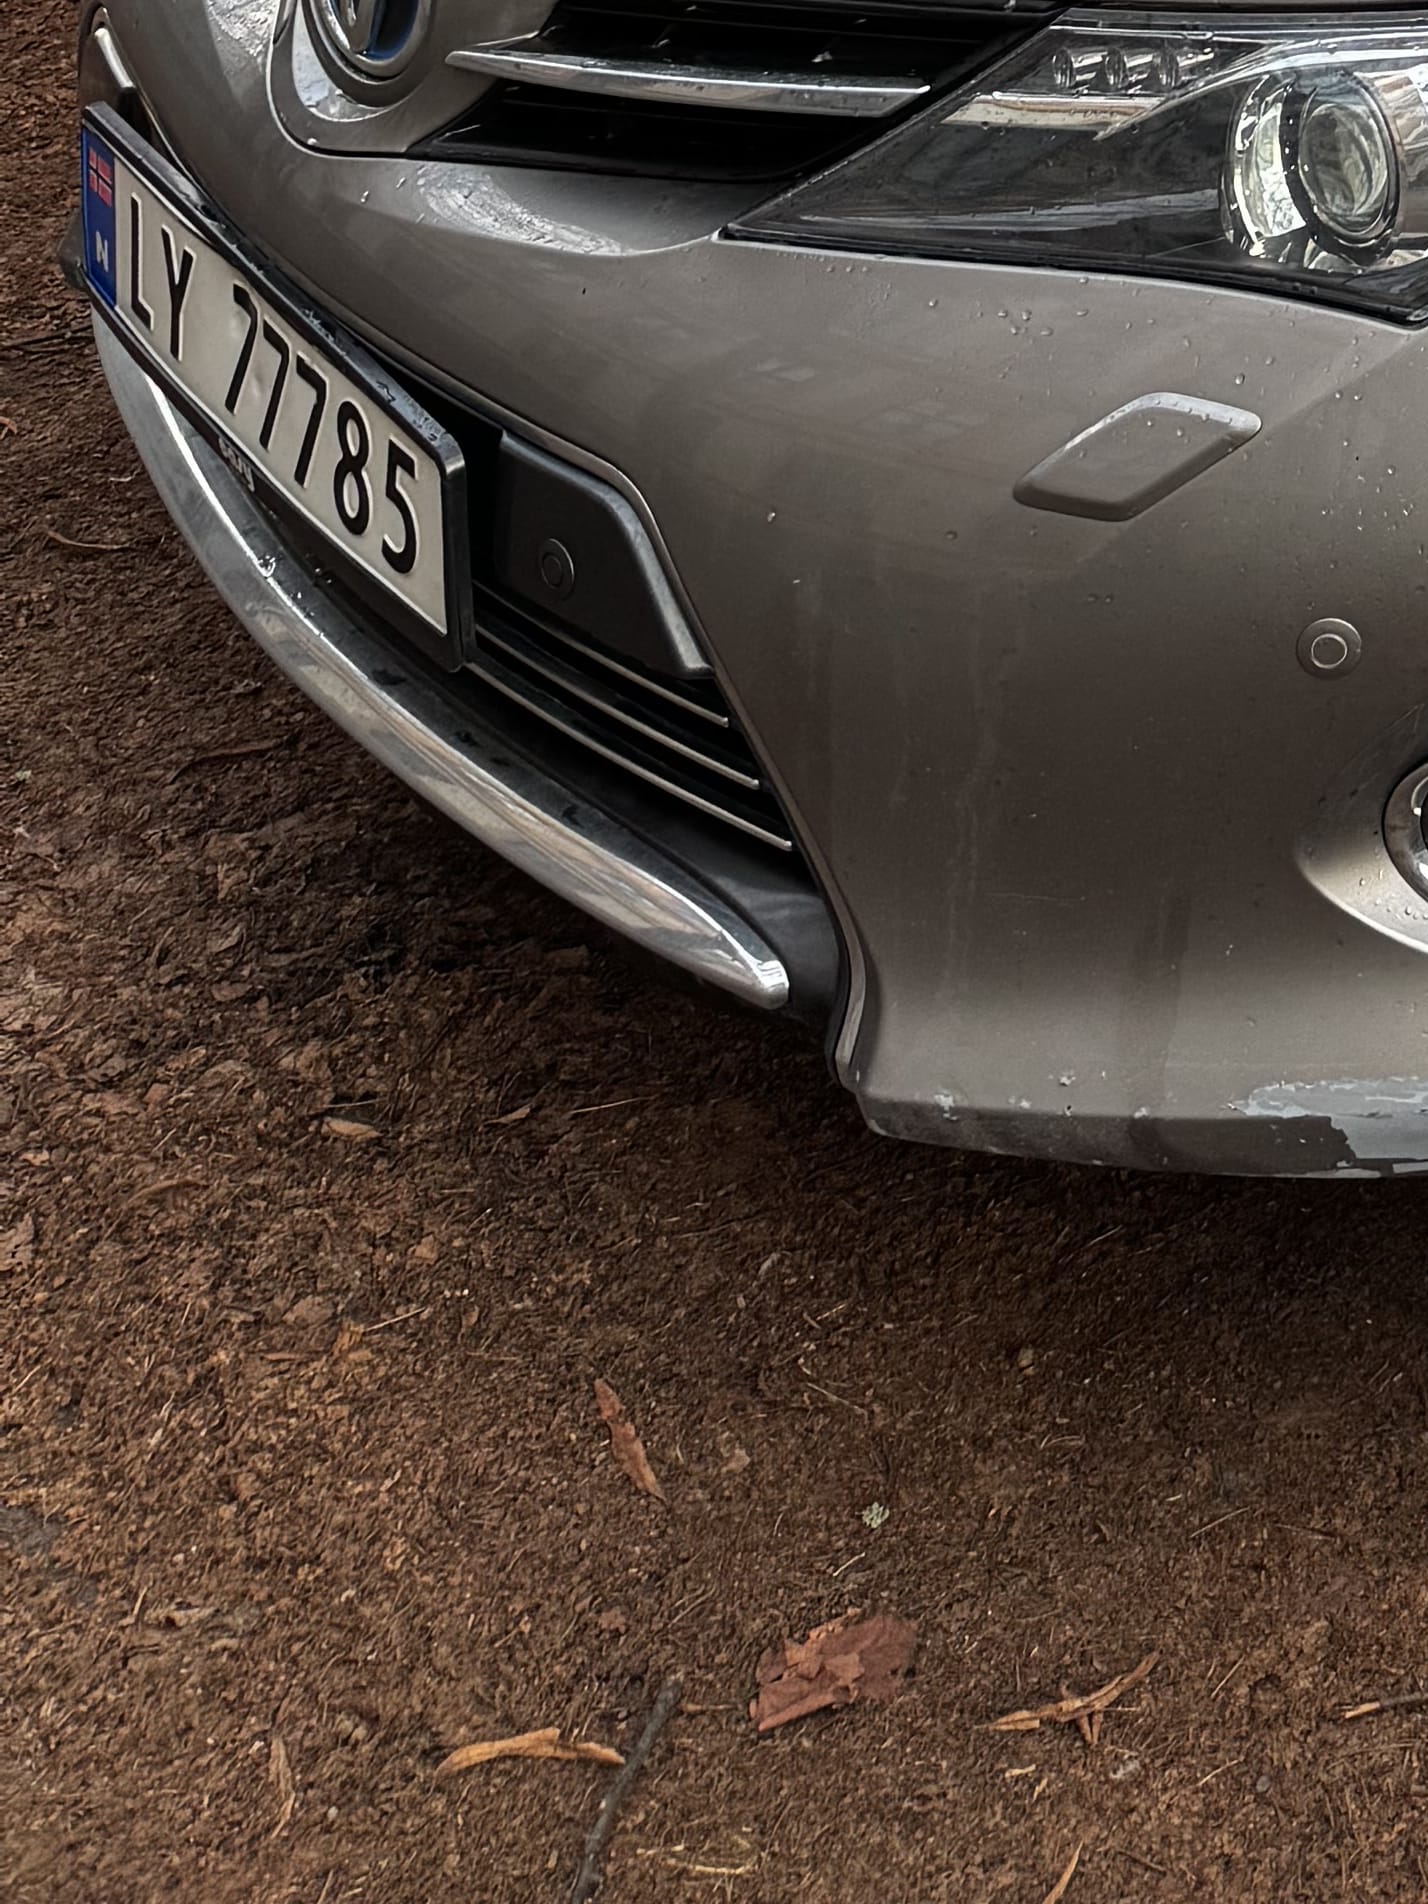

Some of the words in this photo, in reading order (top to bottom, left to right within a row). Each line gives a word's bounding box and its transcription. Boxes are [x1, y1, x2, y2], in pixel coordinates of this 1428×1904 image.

[95, 230, 109, 273] N
[129, 194, 196, 360] LY
[224, 282, 418, 574] 77785
